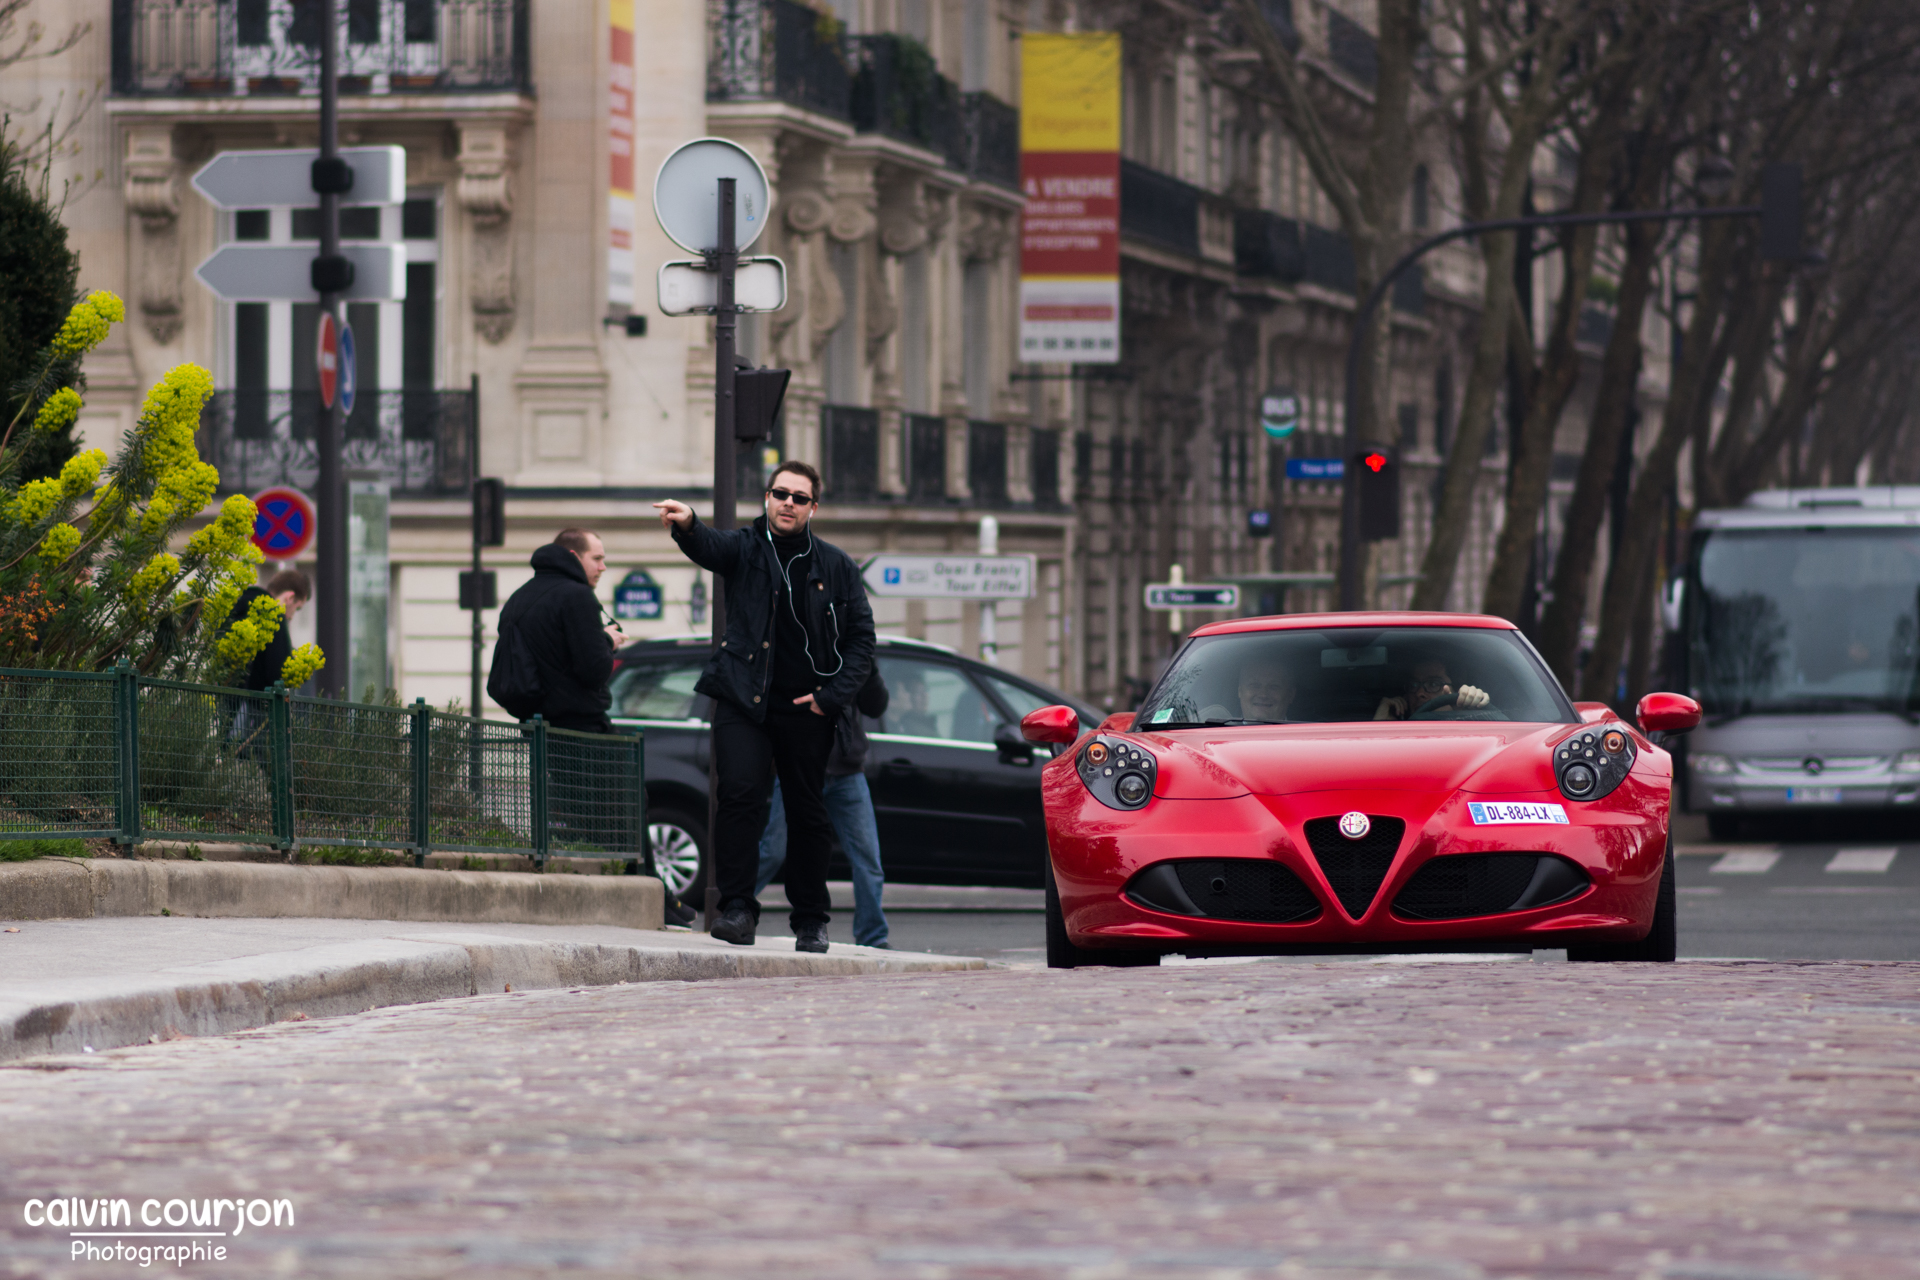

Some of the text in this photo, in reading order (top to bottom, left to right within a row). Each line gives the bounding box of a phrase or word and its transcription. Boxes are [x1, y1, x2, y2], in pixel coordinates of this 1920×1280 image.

[1025, 177, 1115, 197] A VENDRE
[1263, 398, 1295, 416] BUS
[934, 562, 967, 576] Quai
[974, 562, 1021, 578] Branly
[946, 579, 1021, 592] Tour Eiffel
[1486, 805, 1551, 821] DL-884-LX
